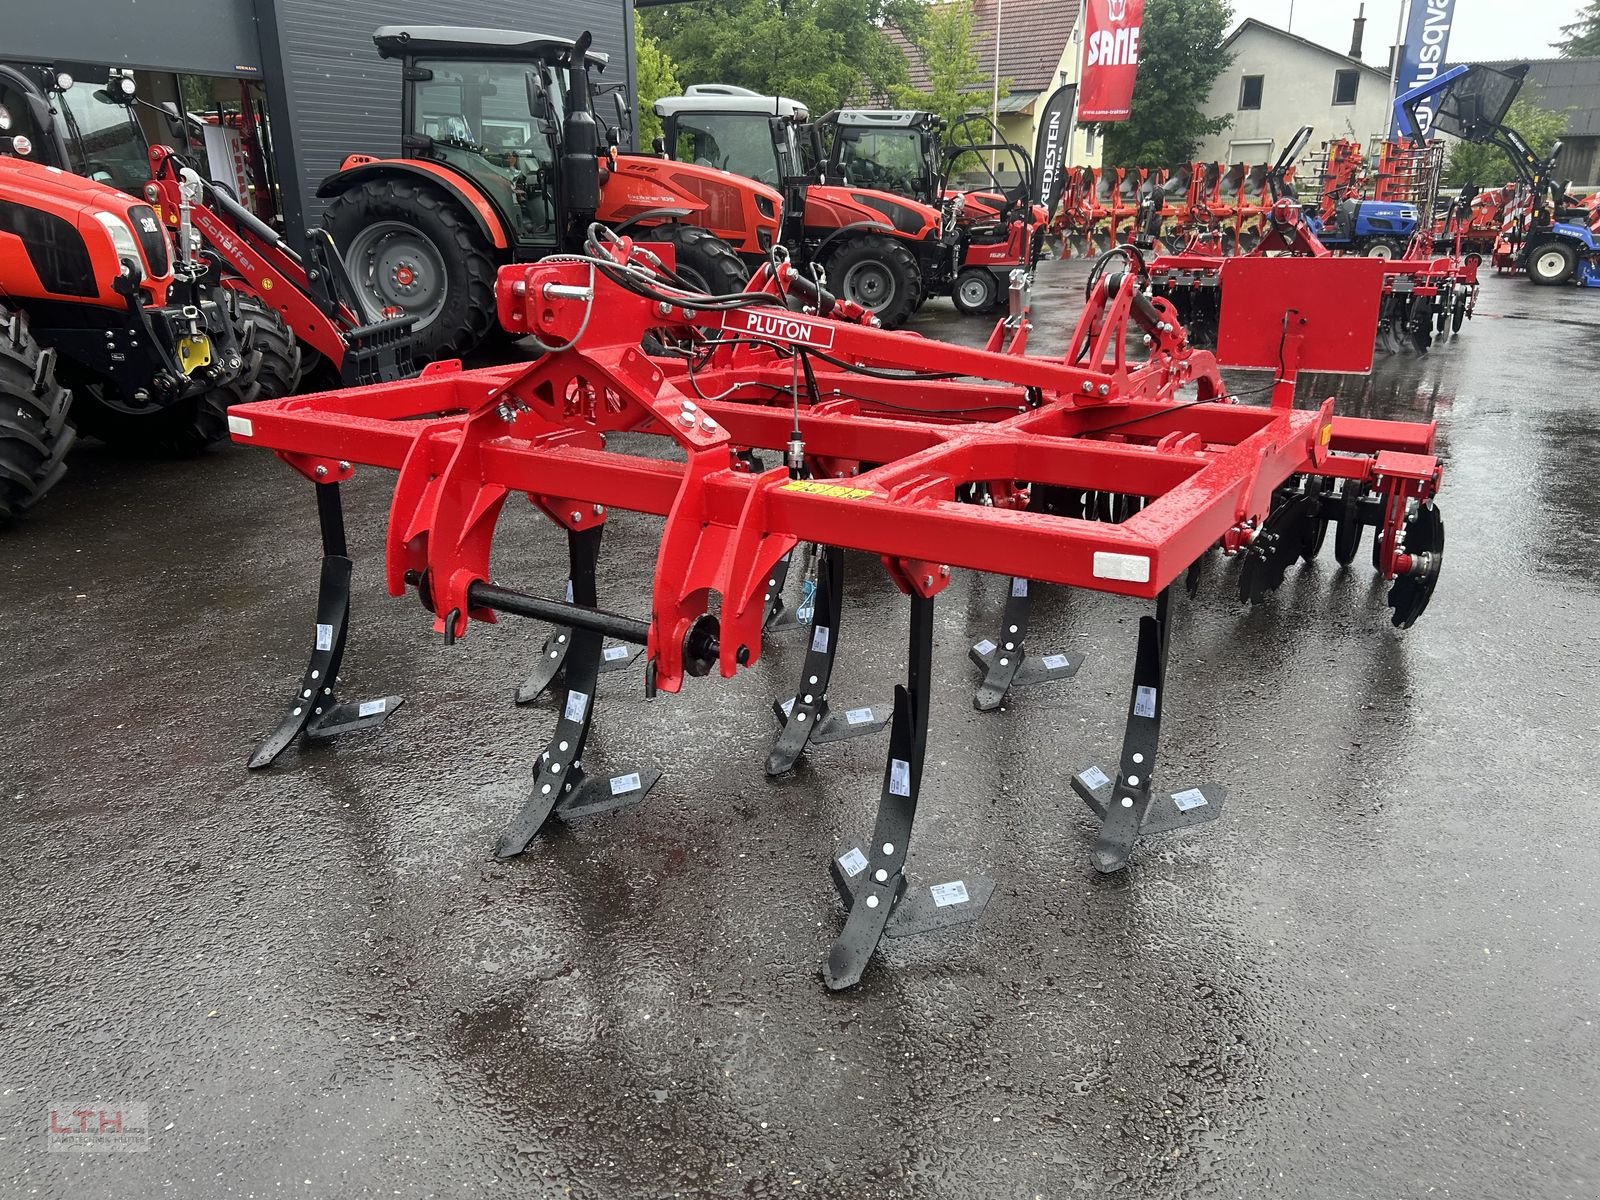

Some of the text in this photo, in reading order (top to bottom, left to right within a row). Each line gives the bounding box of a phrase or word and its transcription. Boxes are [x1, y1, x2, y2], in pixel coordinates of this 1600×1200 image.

[1087, 26, 1140, 67] SAME
[197, 216, 255, 272] Schäffer
[746, 313, 812, 341] PLUTON
